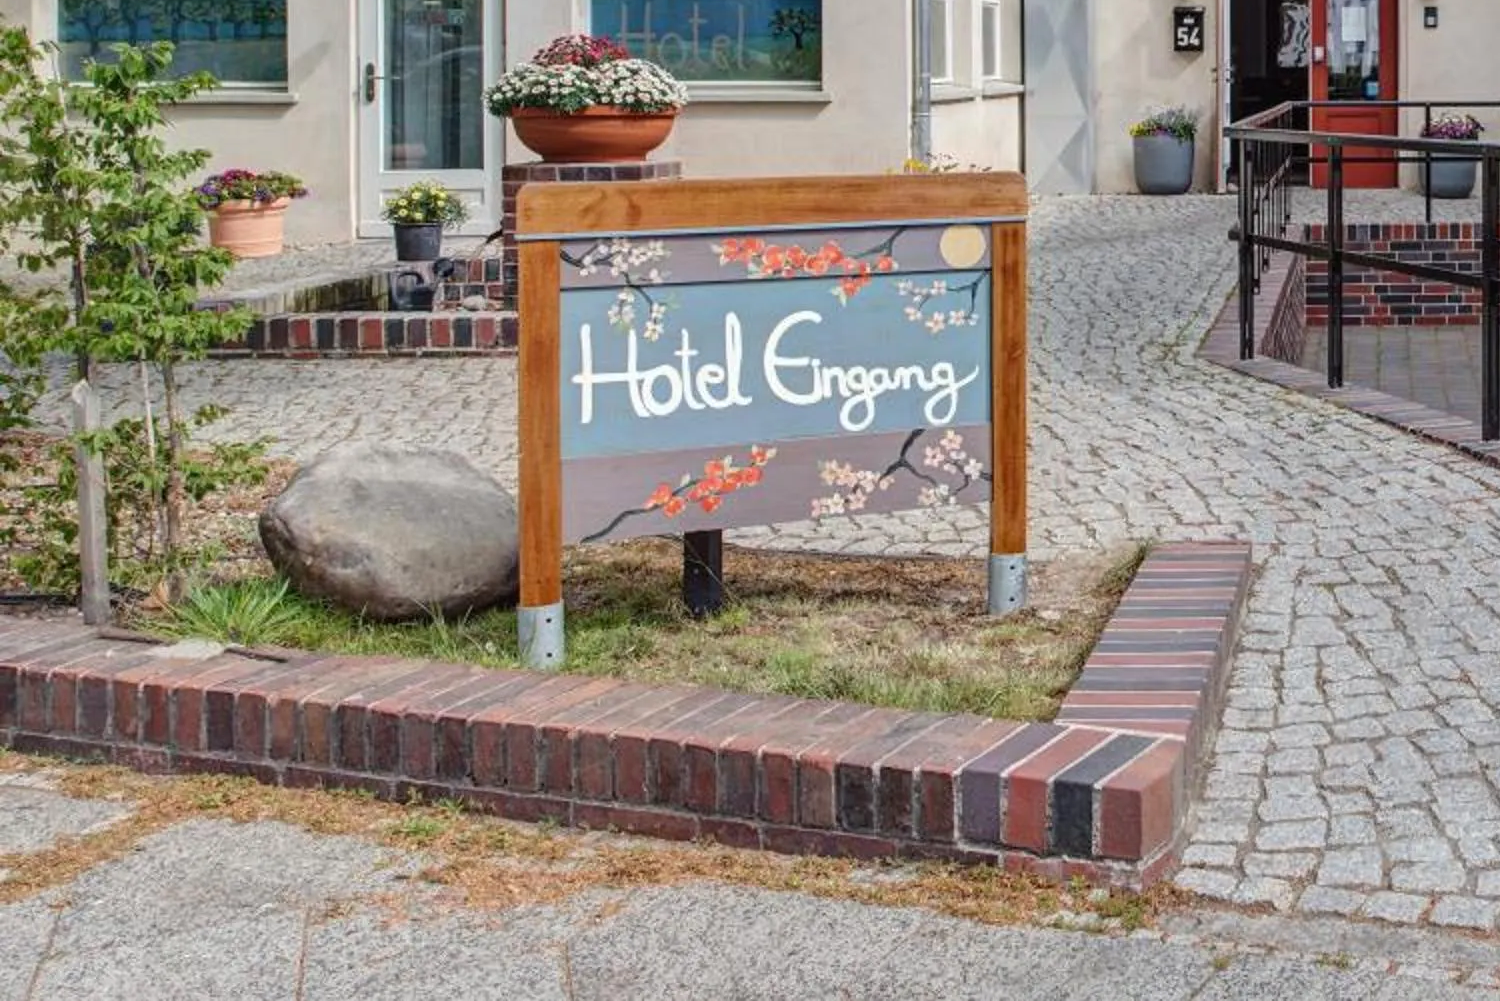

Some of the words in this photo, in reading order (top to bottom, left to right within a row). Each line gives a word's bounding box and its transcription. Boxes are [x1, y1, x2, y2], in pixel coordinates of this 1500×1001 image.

[617, 0, 747, 72] Hotel
[1177, 26, 1200, 46] 54
[572, 312, 752, 423] Hotel
[764, 311, 980, 430] Eingang
